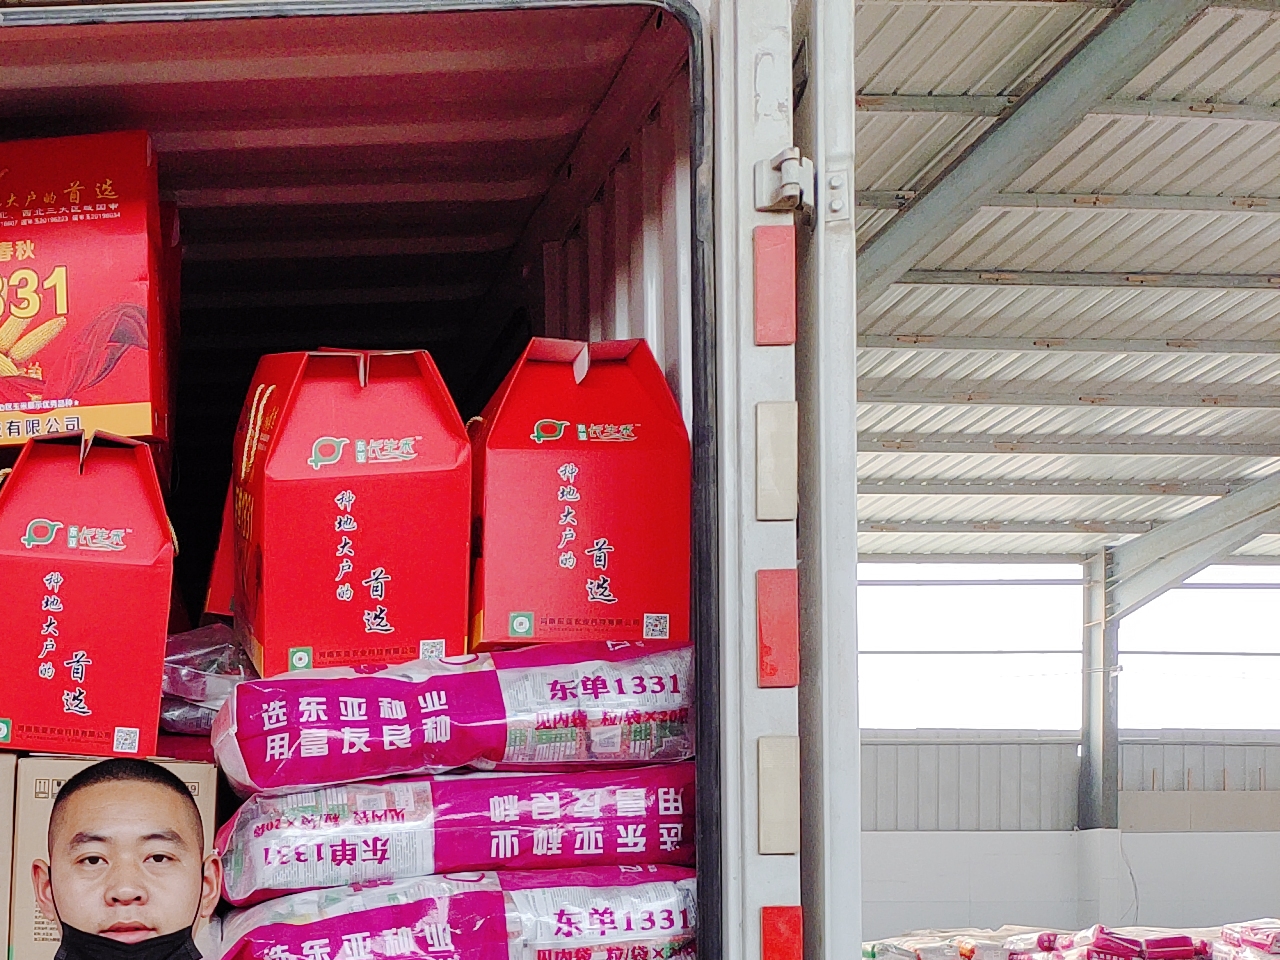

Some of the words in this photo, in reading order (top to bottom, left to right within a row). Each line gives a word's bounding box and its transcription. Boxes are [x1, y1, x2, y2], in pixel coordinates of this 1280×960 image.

[557, 463, 580, 569] 种地大户的
[335, 490, 357, 601] 种地大户的
[585, 538, 618, 604] 首选
[362, 567, 395, 633] 首选
[38, 572, 64, 679] 种地大户的
[62, 652, 93, 716] 首选
[546, 673, 681, 701] 东单1331
[262, 690, 450, 731] 选东亚种业
[264, 715, 452, 764] 用富友良种
[489, 787, 684, 823] 用富友良种
[263, 836, 391, 867] 东单1331
[490, 823, 684, 859] 选东亚种业
[553, 907, 691, 938] 东单1331
